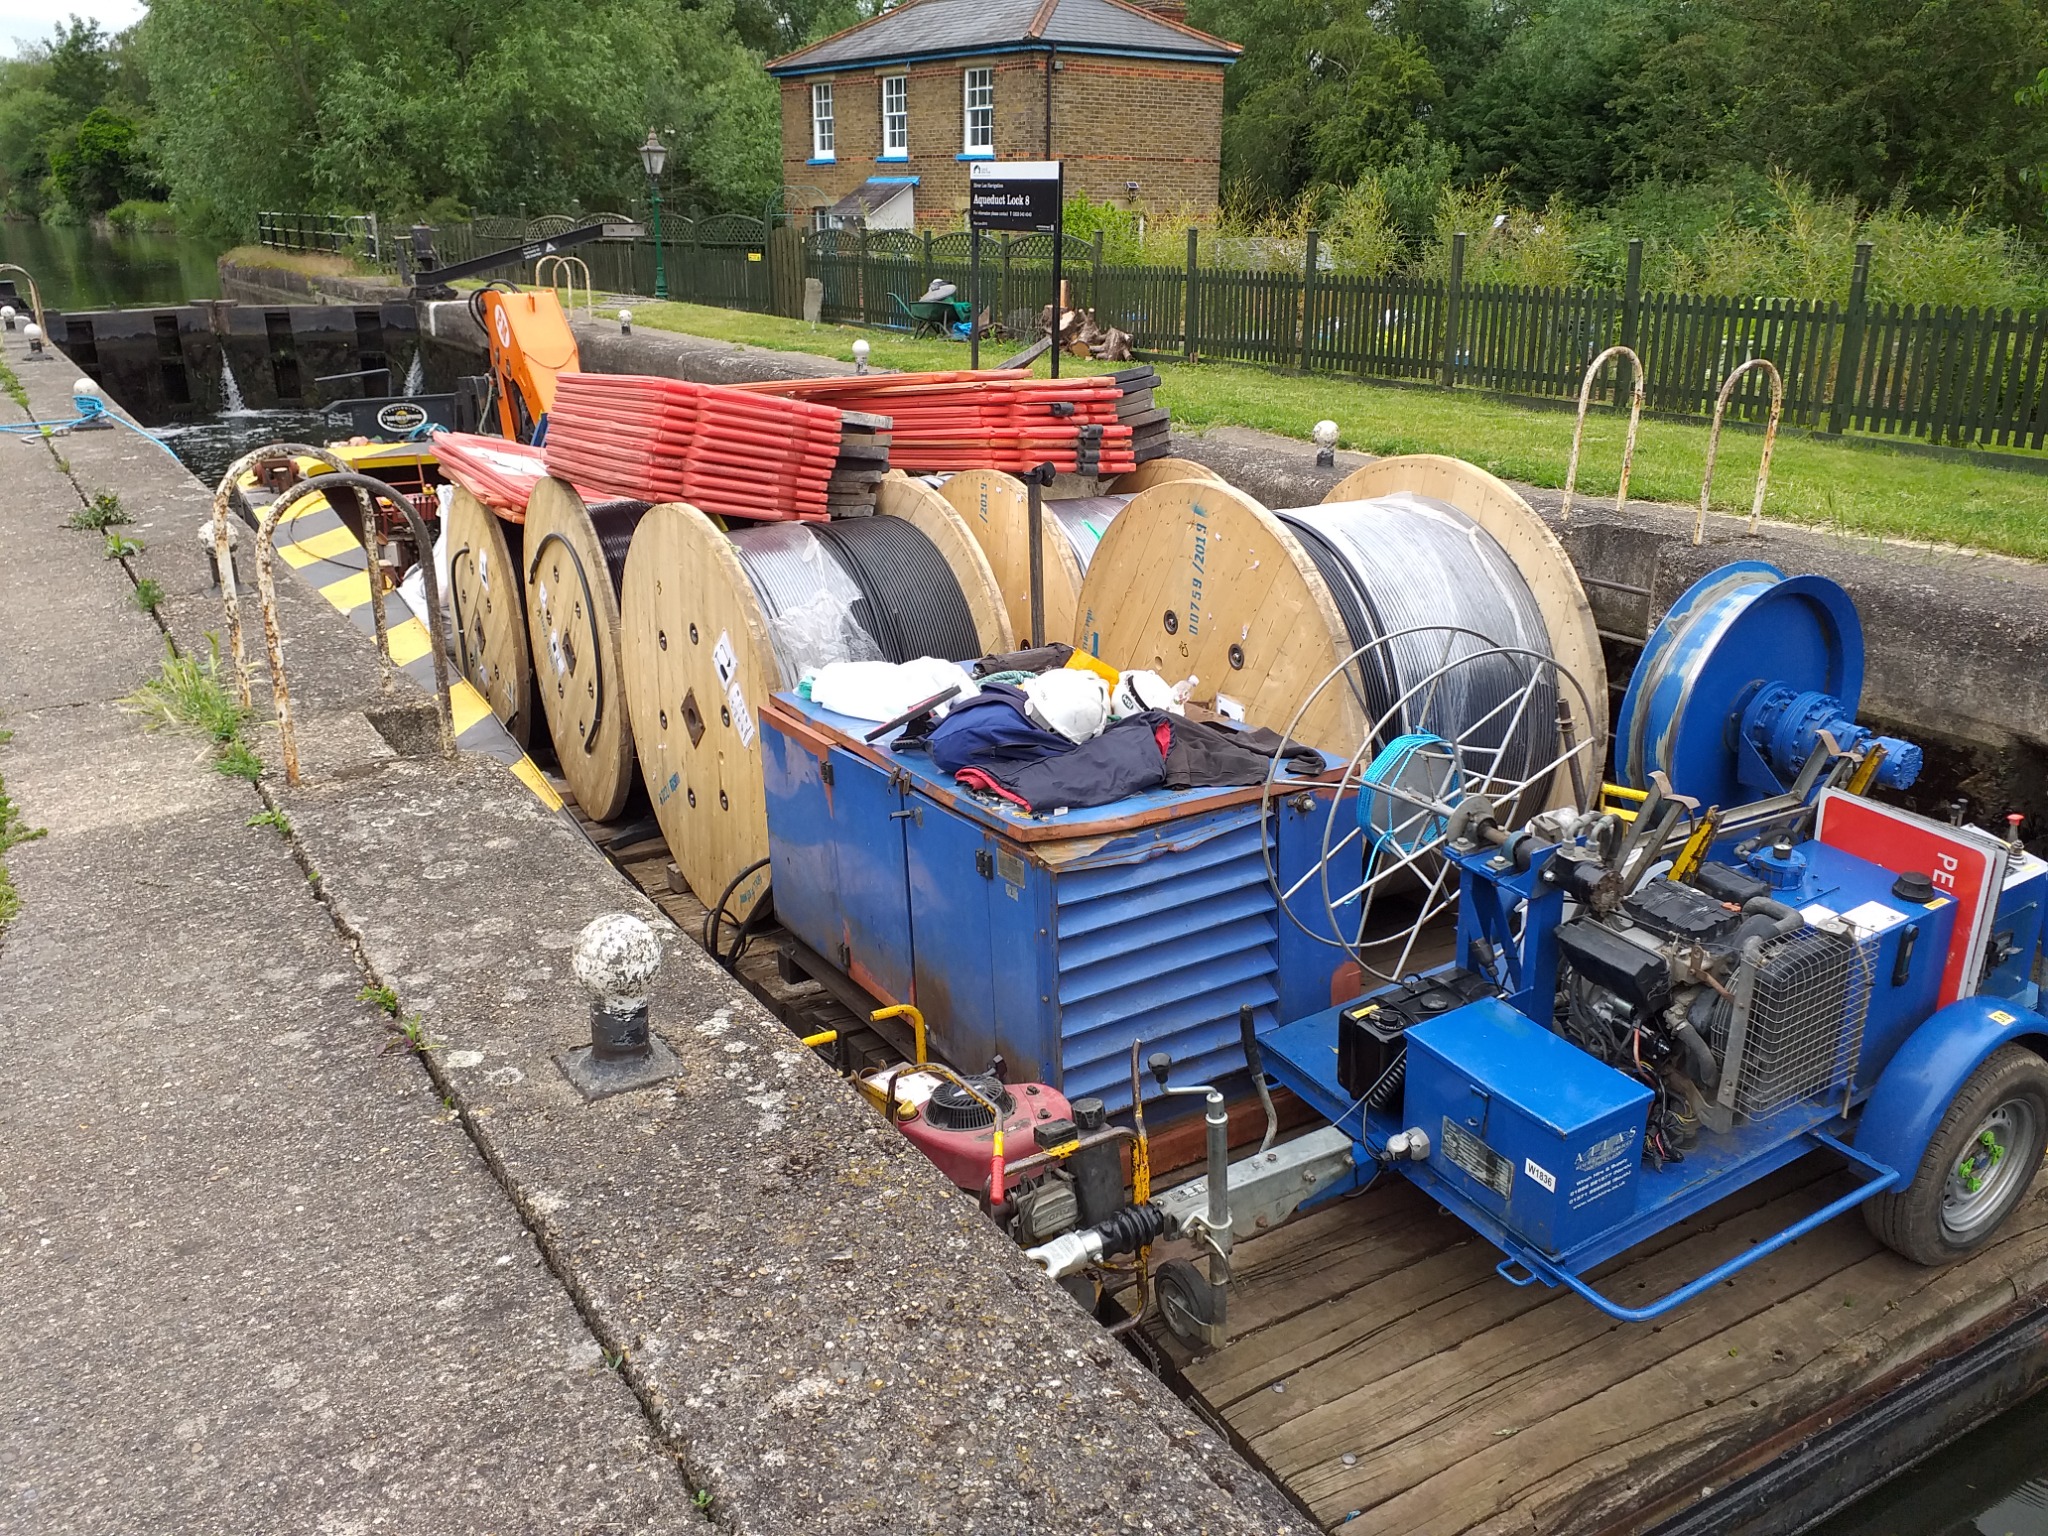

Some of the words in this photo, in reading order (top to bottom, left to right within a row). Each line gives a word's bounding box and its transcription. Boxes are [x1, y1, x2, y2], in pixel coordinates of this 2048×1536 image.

[973, 194, 1006, 207] Aqueduct
[1007, 194, 1024, 205] Lock
[1025, 195, 1030, 206] 8
[1932, 852, 1958, 895] PE
[1574, 1125, 1637, 1165] ATLAS
[1528, 1162, 1552, 1187] W1836
